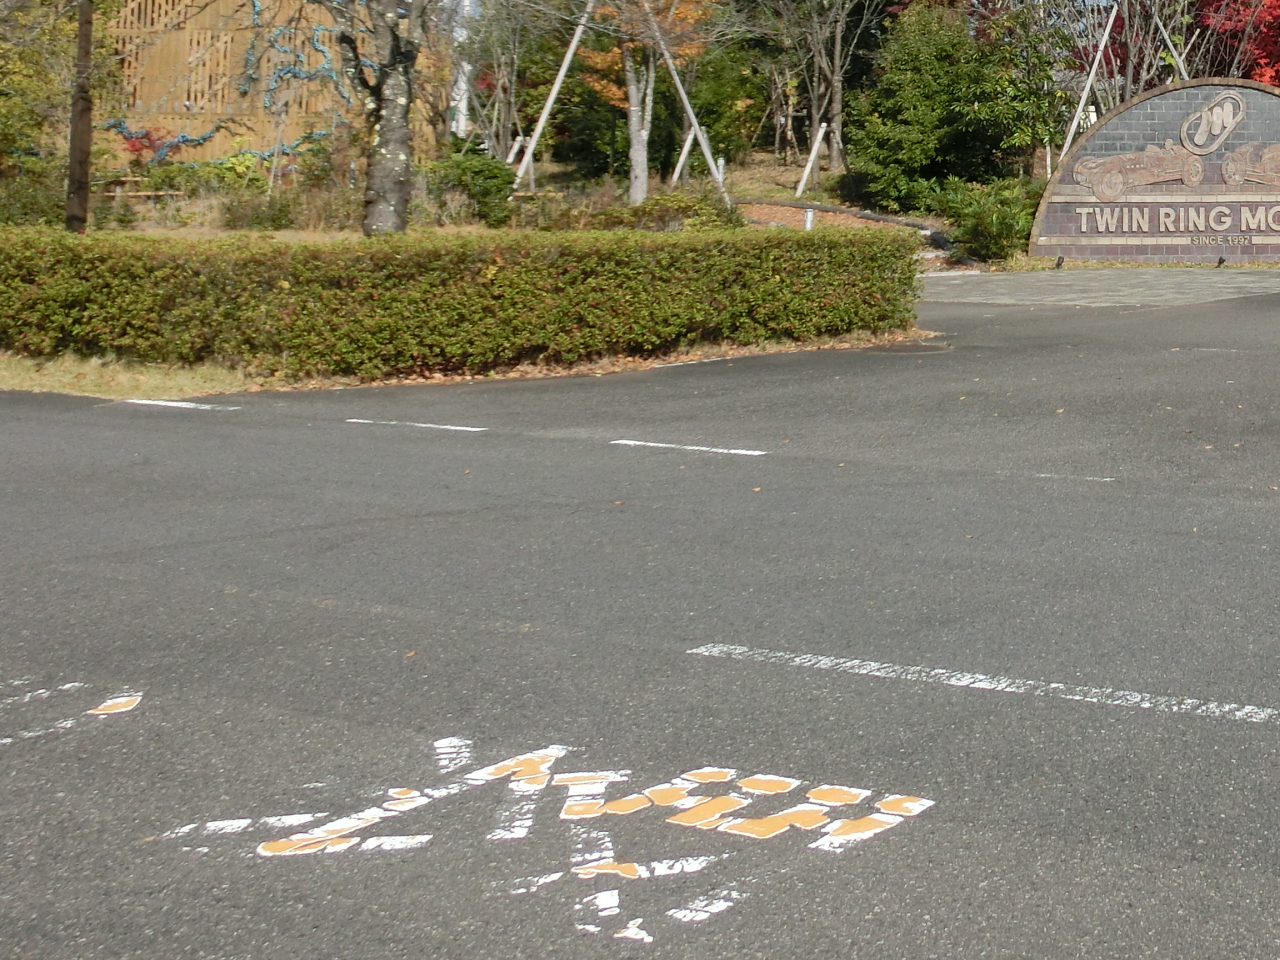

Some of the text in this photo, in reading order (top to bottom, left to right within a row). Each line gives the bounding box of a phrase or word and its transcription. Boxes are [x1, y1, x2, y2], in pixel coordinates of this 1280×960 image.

[1075, 207, 1150, 233] TWIN
[1159, 205, 1233, 232] RING
[1193, 236, 1224, 245] SINCE
